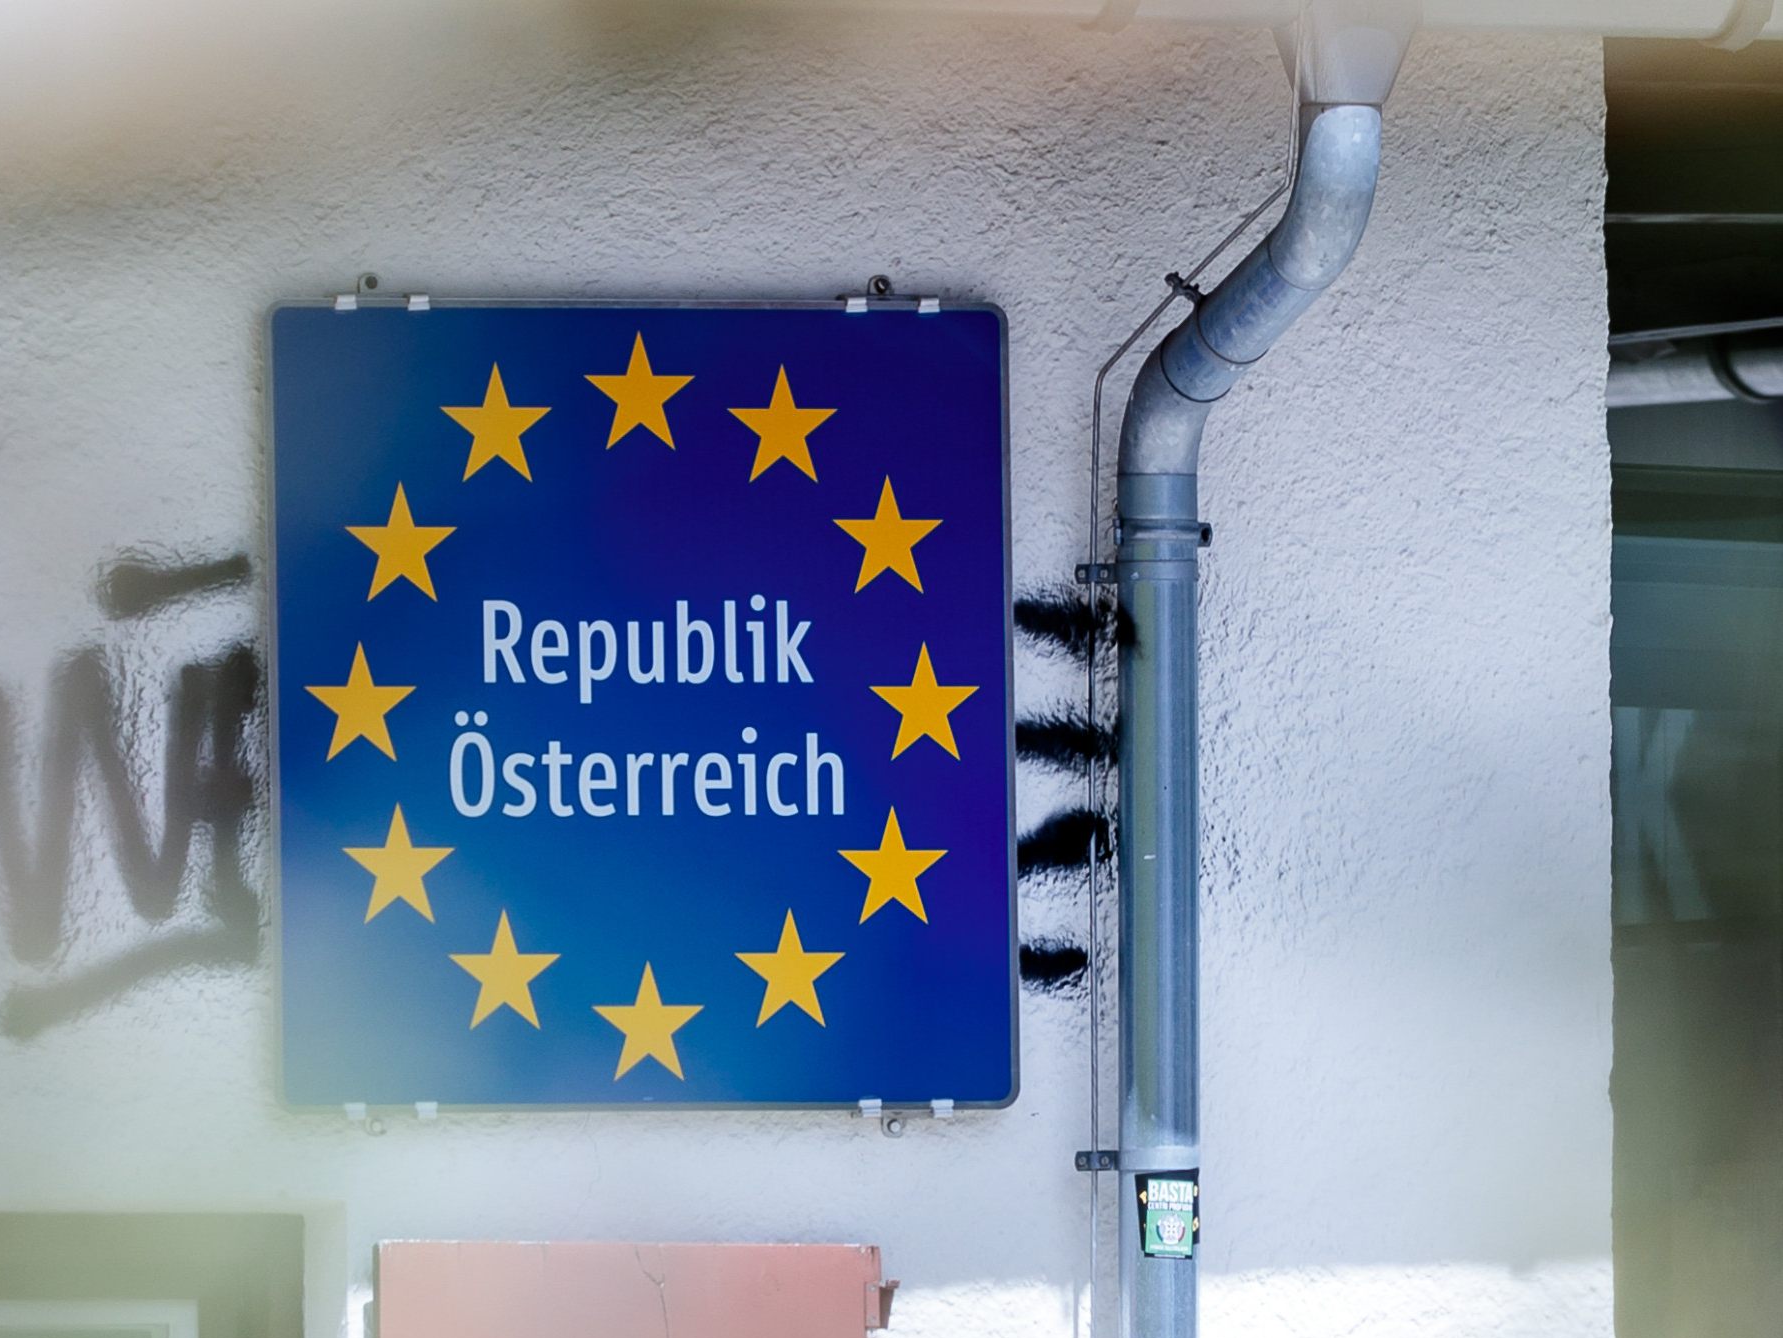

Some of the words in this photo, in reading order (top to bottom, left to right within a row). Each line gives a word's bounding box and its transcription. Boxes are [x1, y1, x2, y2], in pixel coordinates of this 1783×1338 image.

[482, 594, 815, 704] Republik
[448, 710, 846, 818] Österreich
[1148, 1180, 1193, 1203] BASTA
